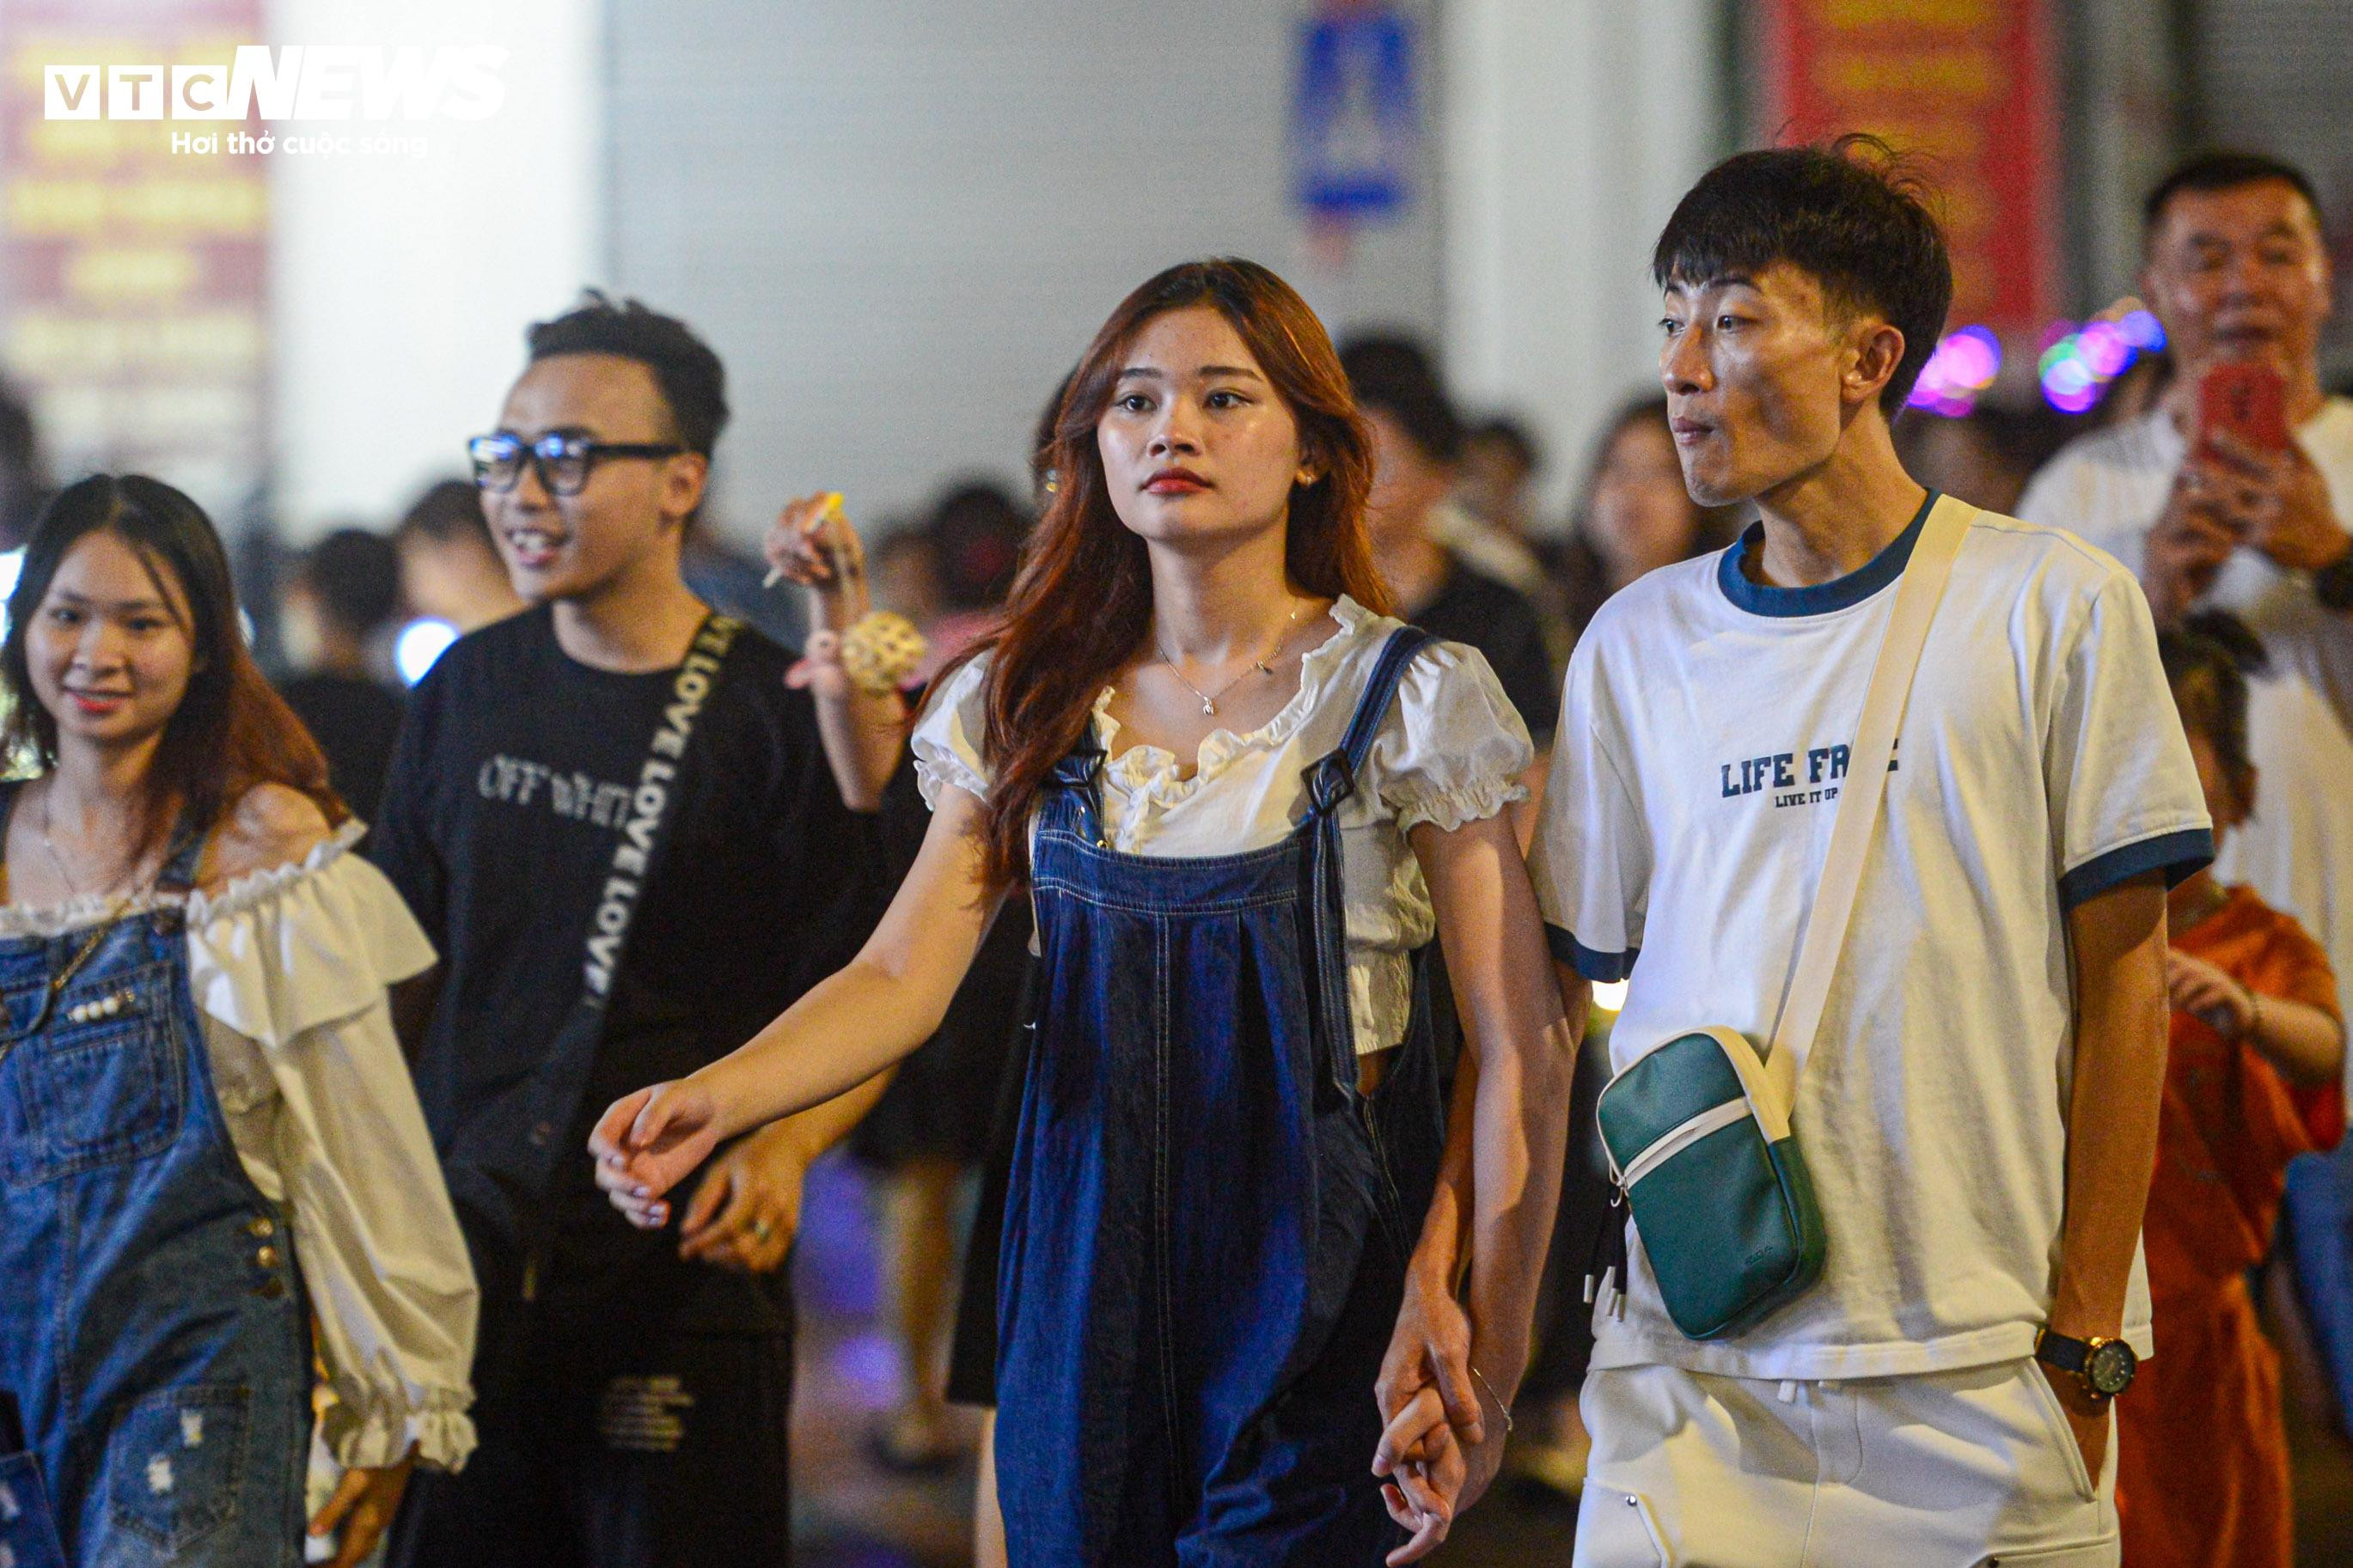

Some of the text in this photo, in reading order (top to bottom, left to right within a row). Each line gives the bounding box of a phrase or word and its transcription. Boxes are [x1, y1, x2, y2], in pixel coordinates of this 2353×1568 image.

[651, 653, 720, 761] LOVE
[550, 771, 634, 830] WHIT
[613, 758, 679, 876] LOVE
[1721, 753, 1795, 798] LIFE
[1775, 792, 1806, 808] LIVE
[1809, 790, 1822, 803] IT
[583, 876, 639, 996] LOVE
